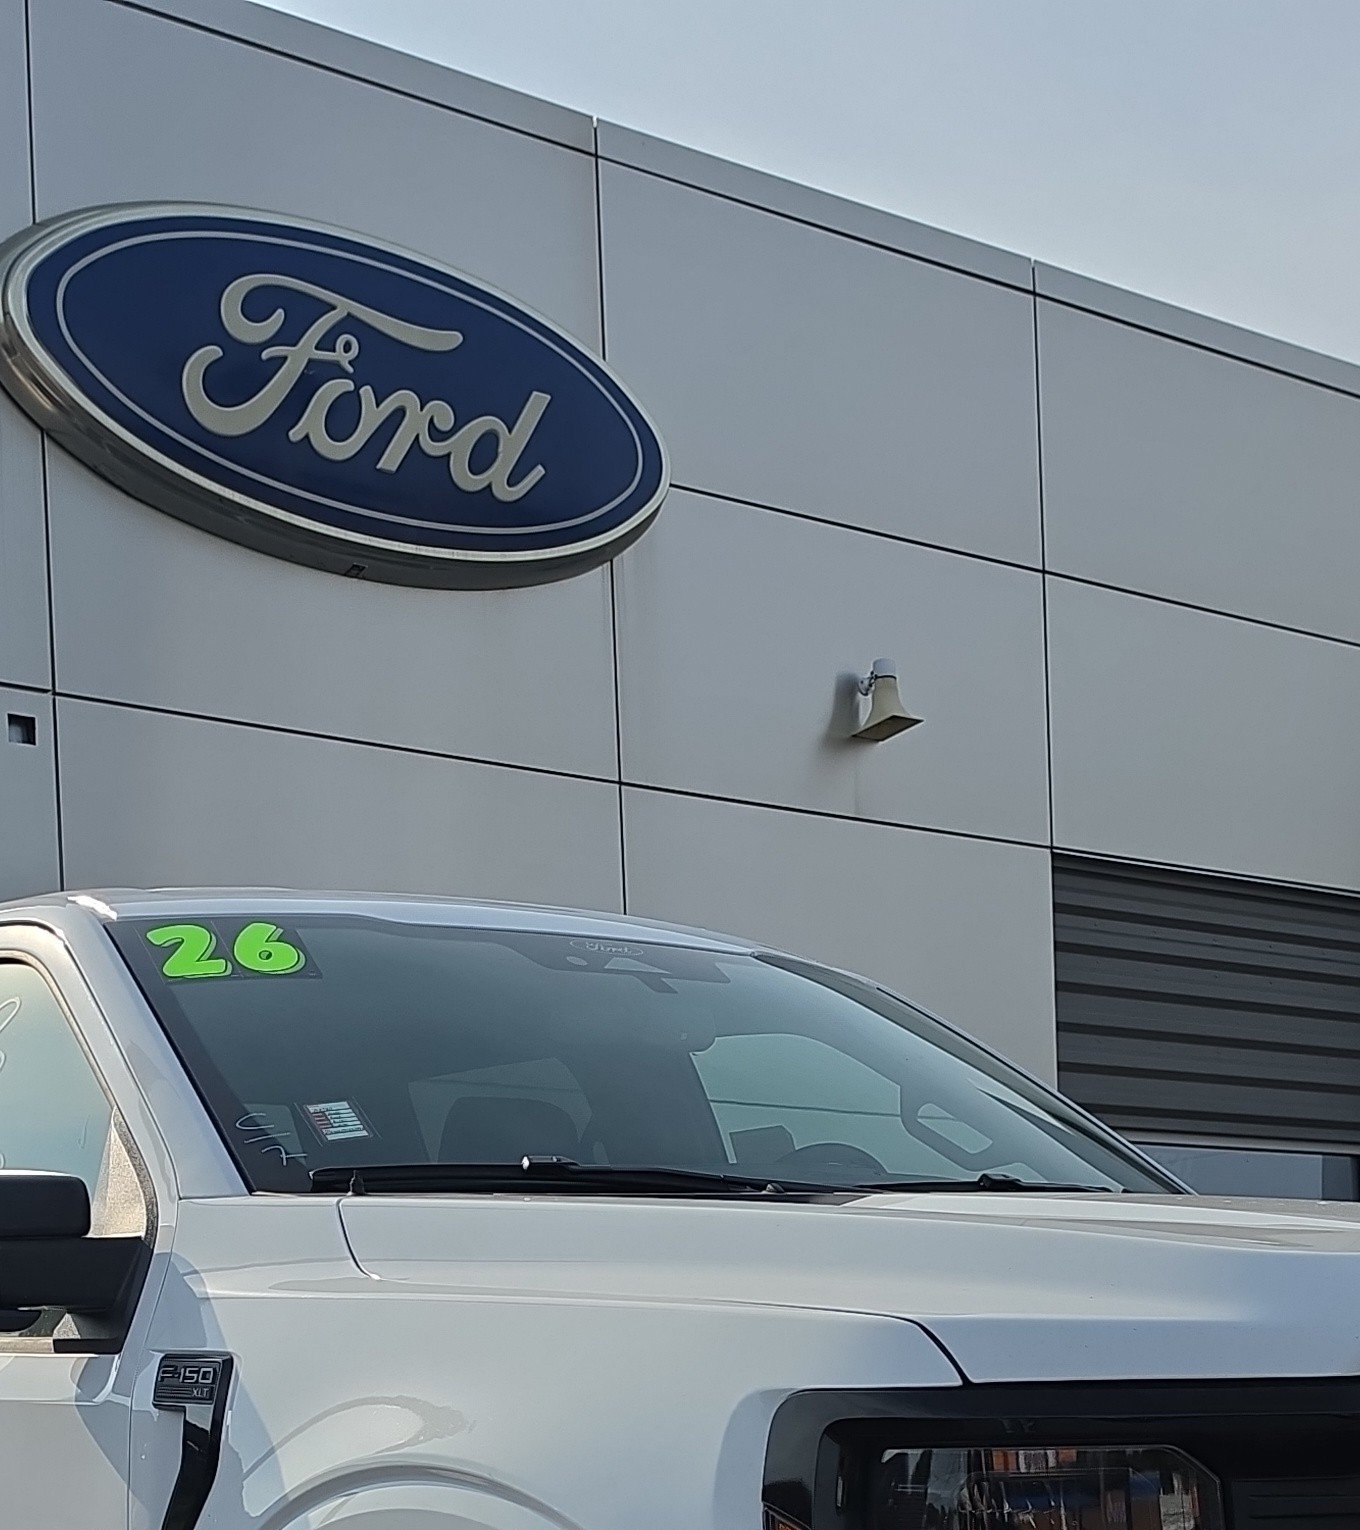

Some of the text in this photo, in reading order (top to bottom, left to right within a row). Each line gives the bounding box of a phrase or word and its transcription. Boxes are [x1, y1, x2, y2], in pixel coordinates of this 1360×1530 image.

[182, 273, 551, 503] Ford
[146, 921, 307, 979] 26
[158, 1366, 215, 1384] F-150
[192, 1387, 210, 1398] XLT
